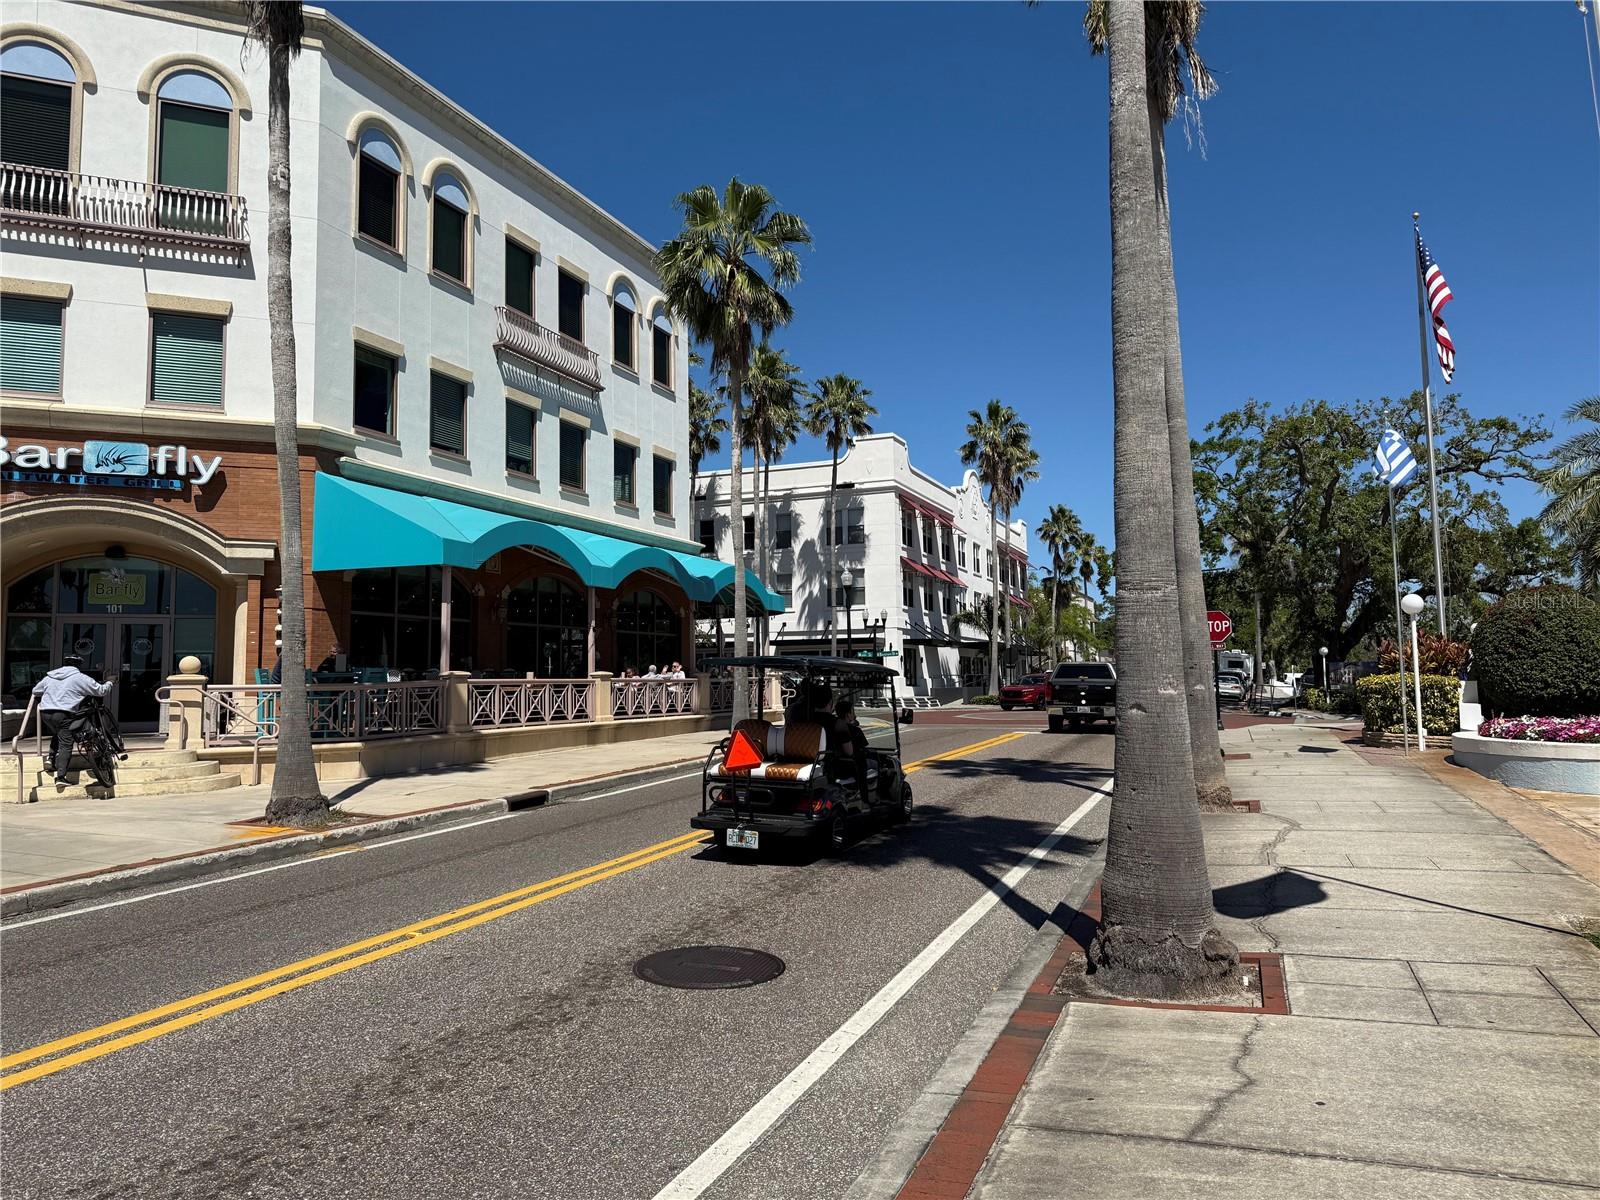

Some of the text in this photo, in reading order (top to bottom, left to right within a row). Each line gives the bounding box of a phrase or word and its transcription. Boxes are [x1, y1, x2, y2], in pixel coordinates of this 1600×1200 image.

[153, 444, 222, 485] fly
[95, 582, 141, 598] Bar fly
[106, 604, 123, 614] 101
[1208, 620, 1230, 632] TOP
